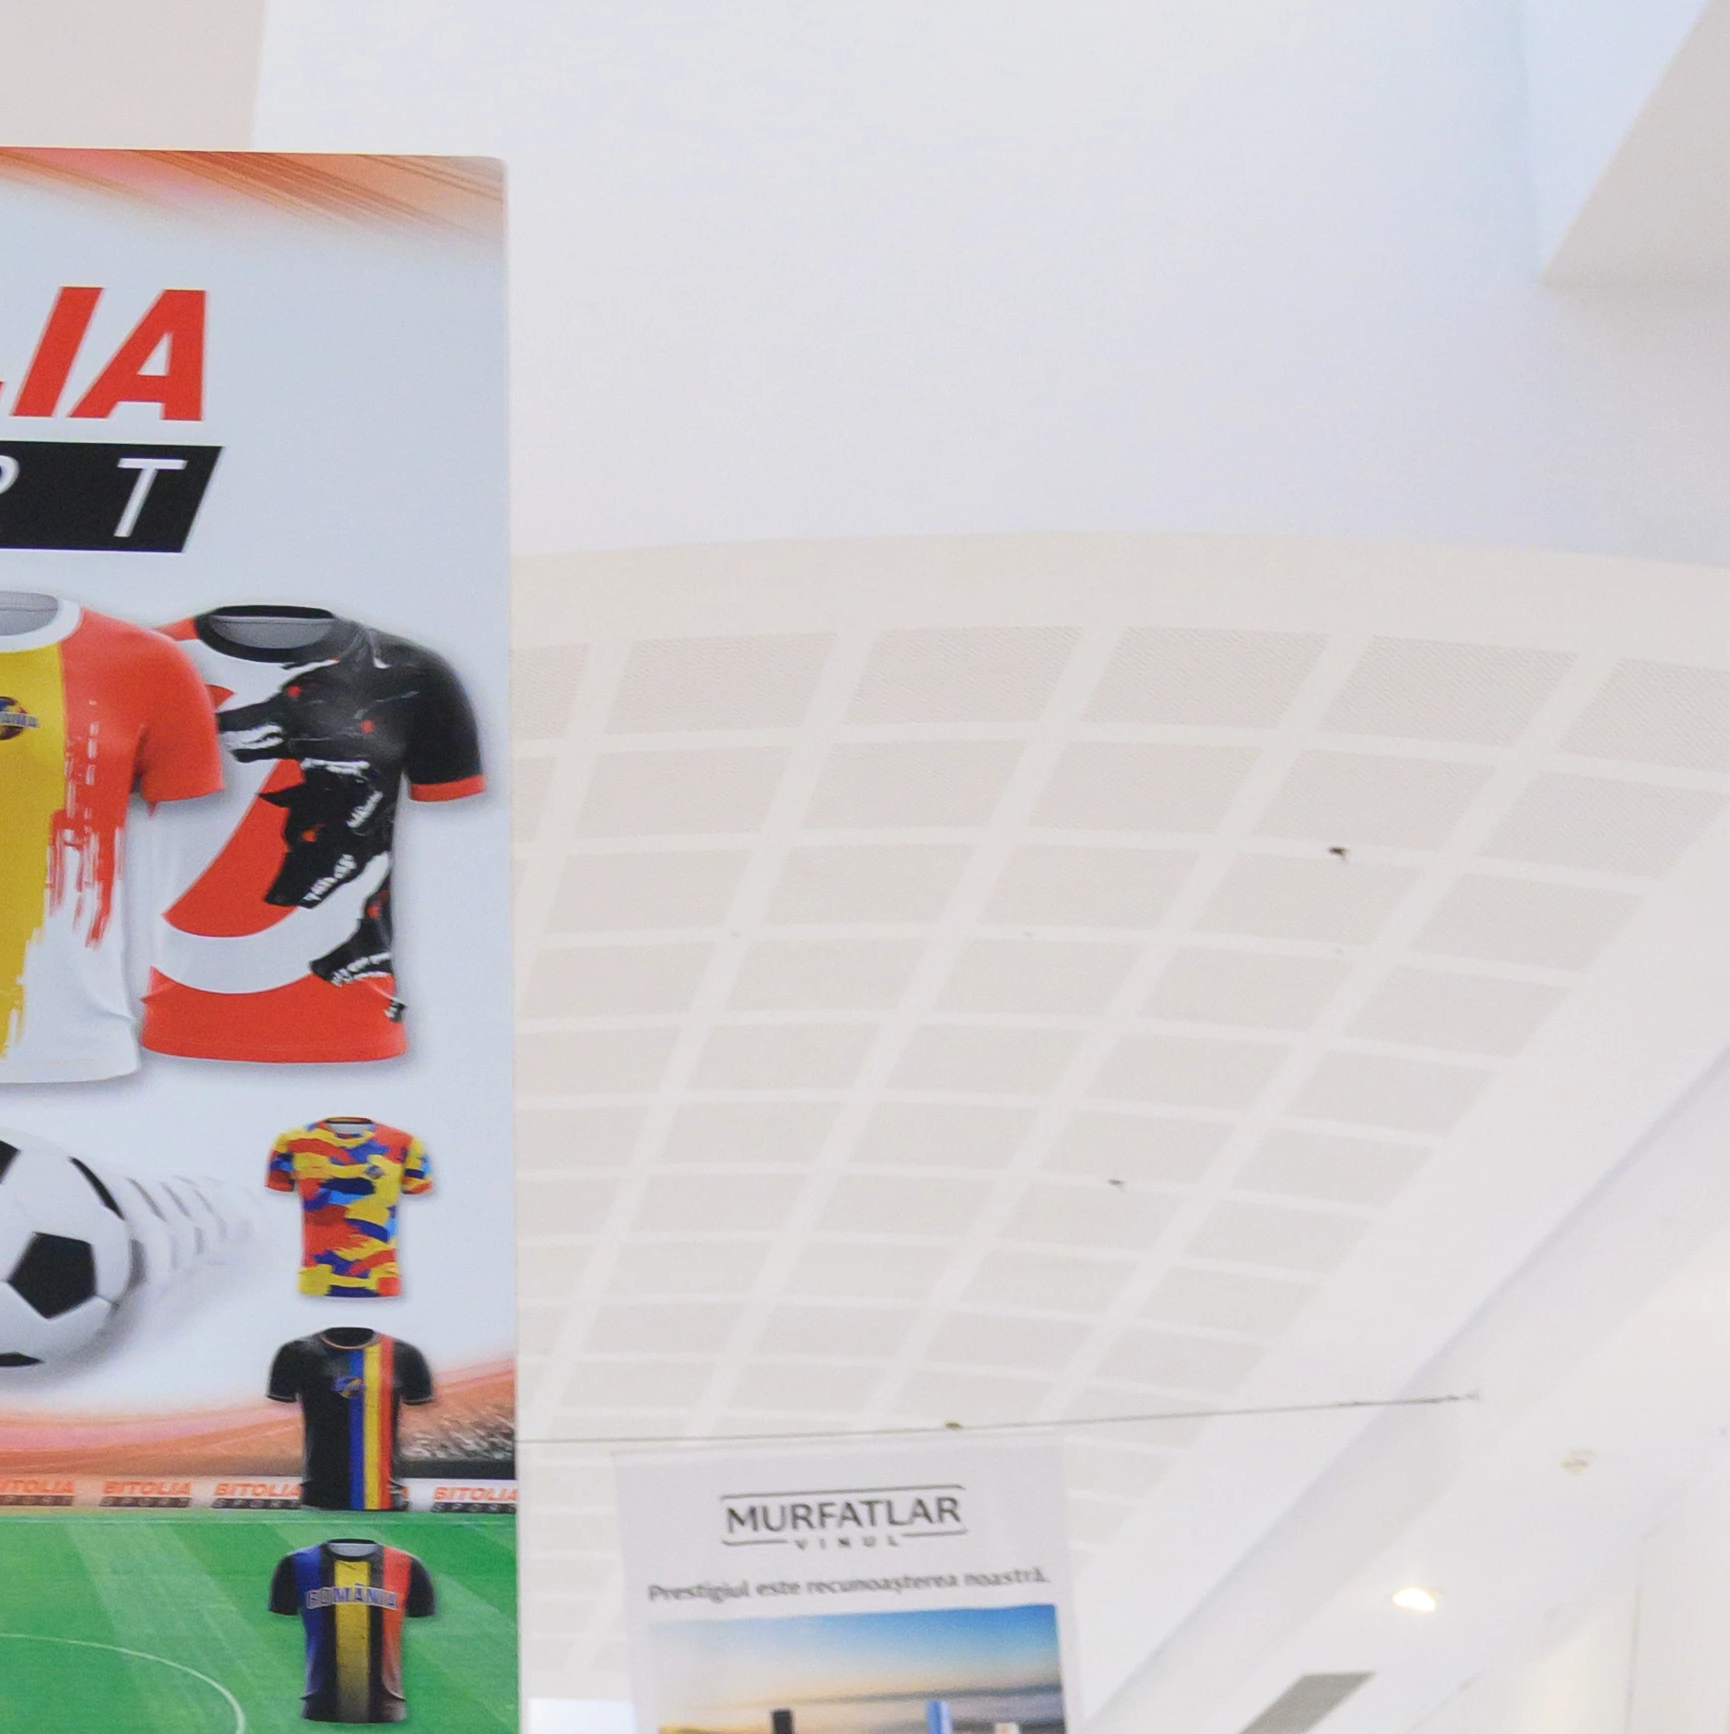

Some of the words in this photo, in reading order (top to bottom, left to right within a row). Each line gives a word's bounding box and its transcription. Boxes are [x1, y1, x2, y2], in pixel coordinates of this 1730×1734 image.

[102, 1481, 191, 1496] BITOLIA
[726, 1497, 961, 1534] MURFATLAR
[756, 1577, 801, 1597] este
